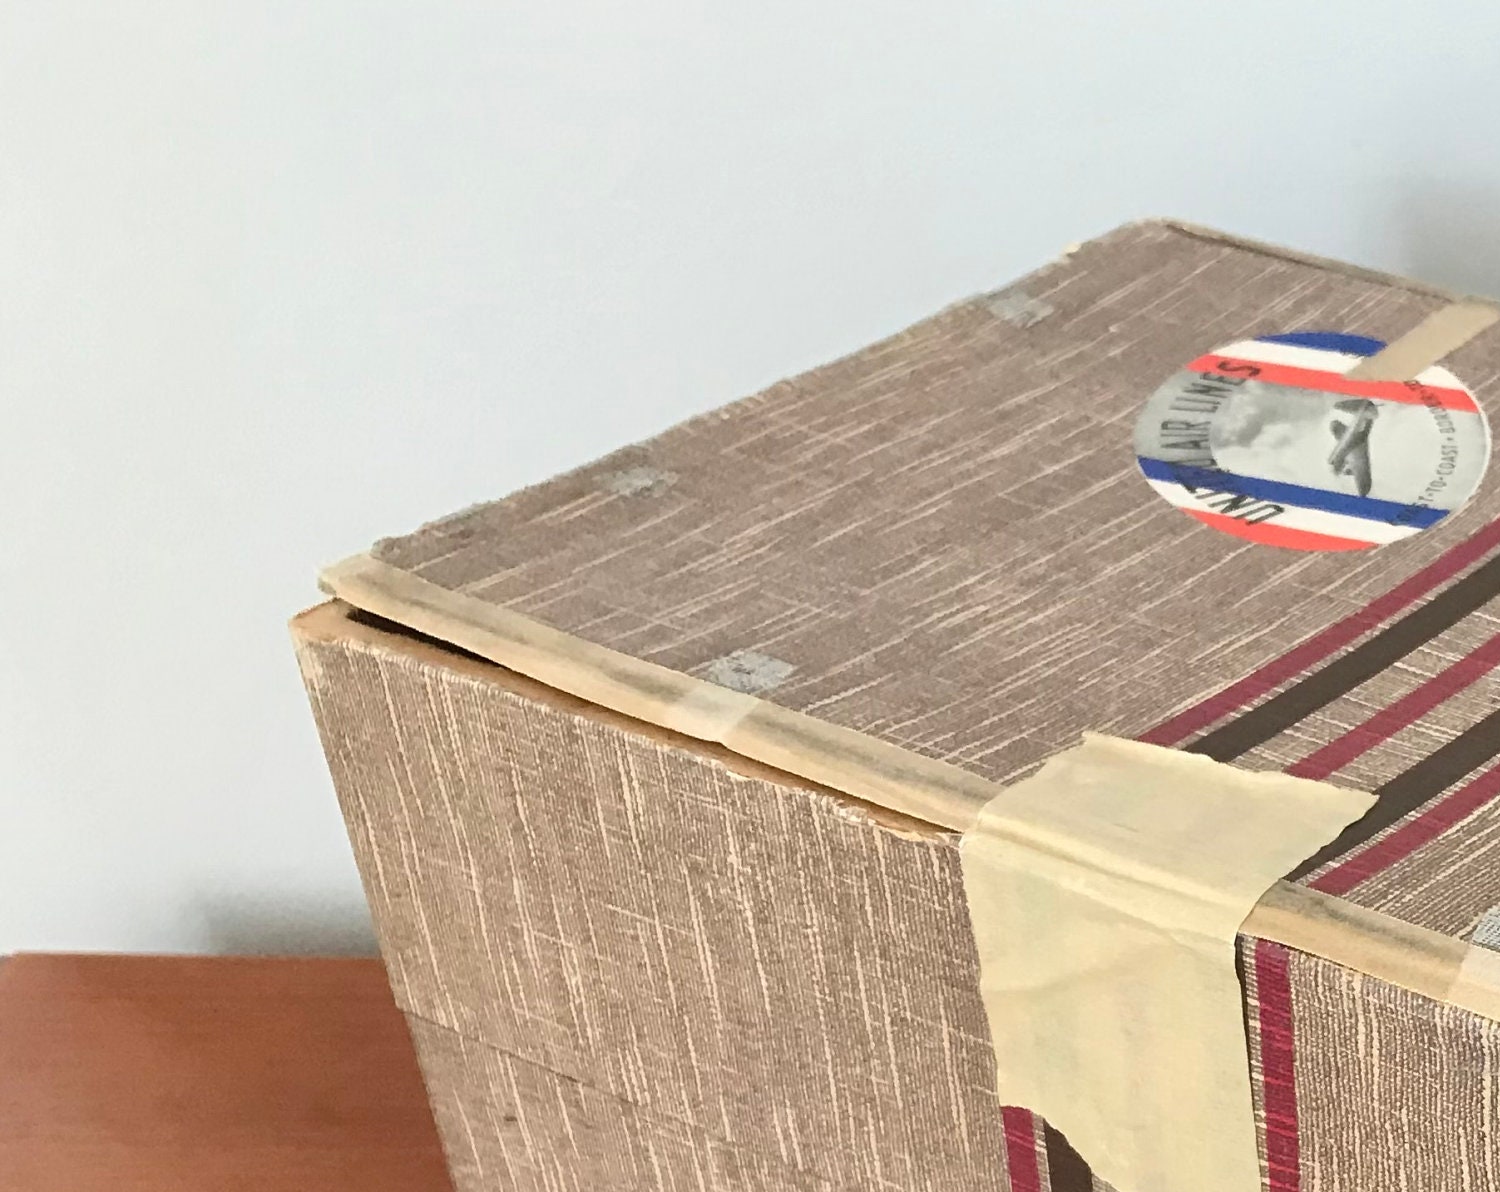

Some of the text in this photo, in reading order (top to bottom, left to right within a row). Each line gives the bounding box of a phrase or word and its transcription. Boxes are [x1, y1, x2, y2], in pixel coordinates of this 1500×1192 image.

[1160, 360, 1285, 526] UNID AIR LINES
[1391, 445, 1459, 525] T-TO-COAST
